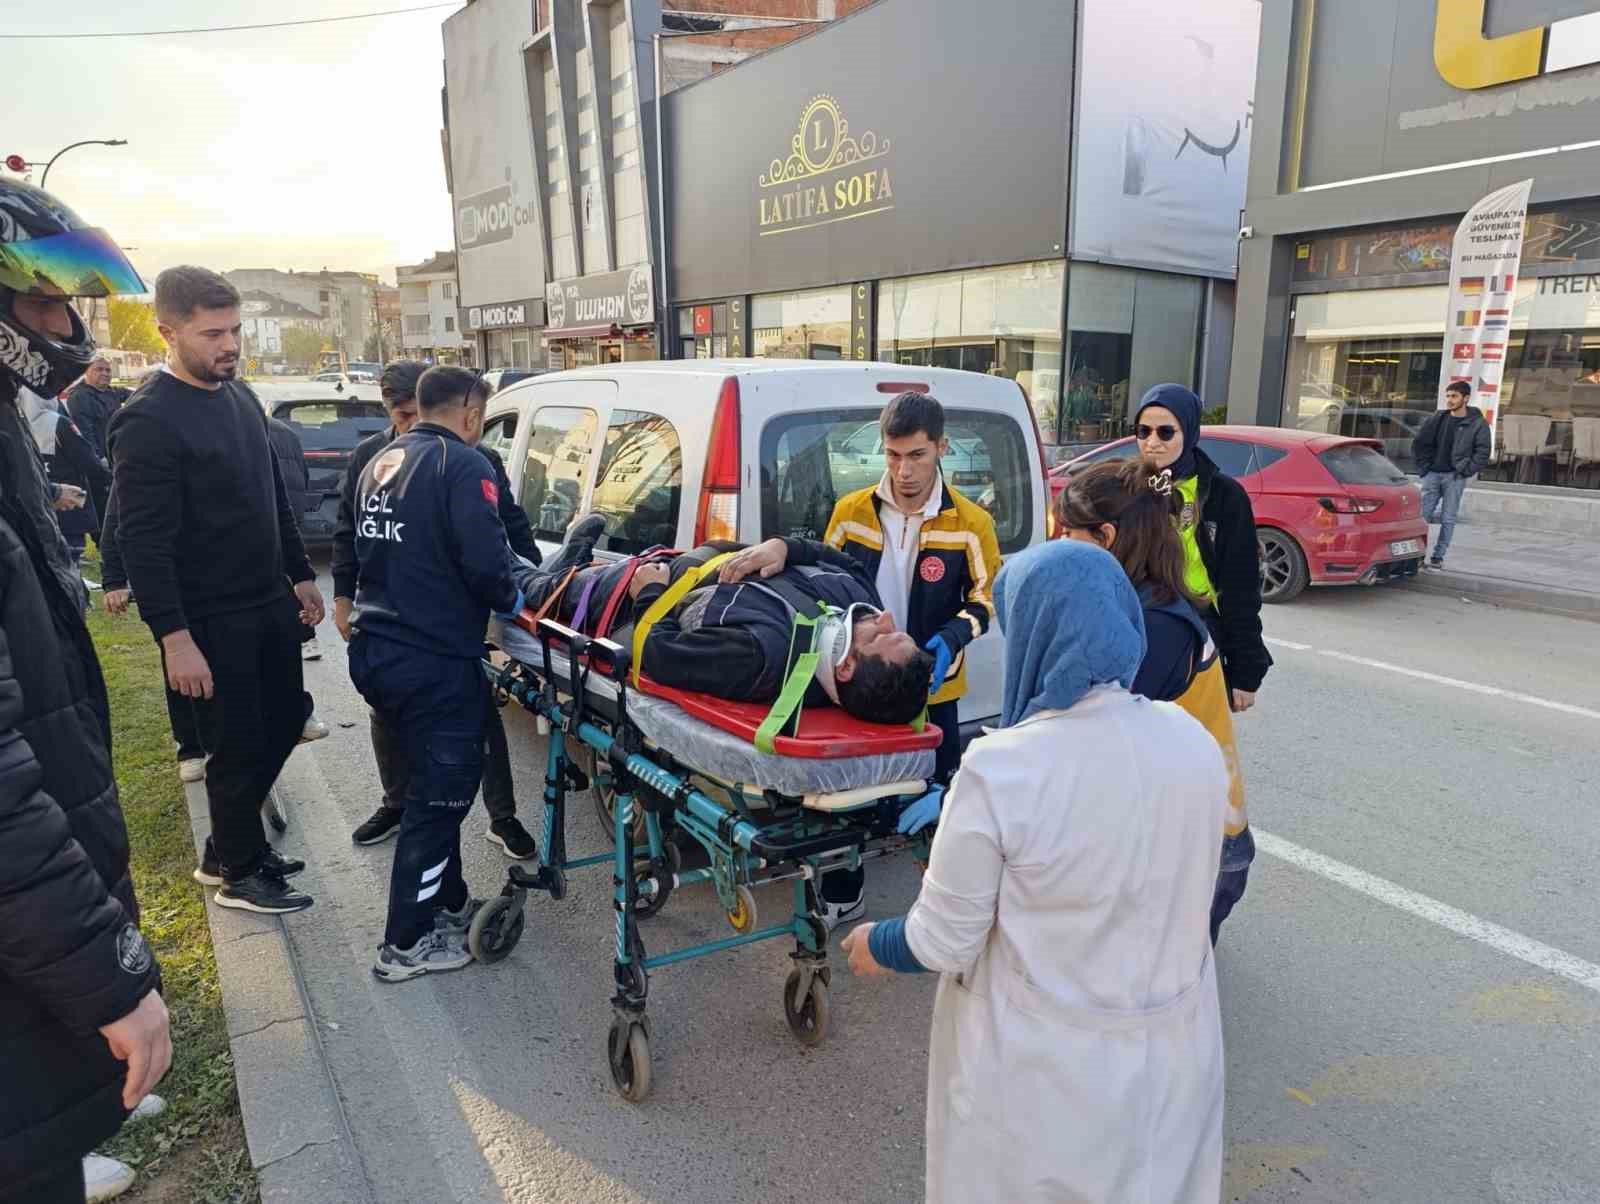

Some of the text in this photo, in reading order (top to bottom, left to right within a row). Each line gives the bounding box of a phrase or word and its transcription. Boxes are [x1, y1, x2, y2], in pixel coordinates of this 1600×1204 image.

[813, 120, 828, 151] L
[759, 168, 893, 226] LATİFA SOFA
[731, 301, 741, 358] CLA
